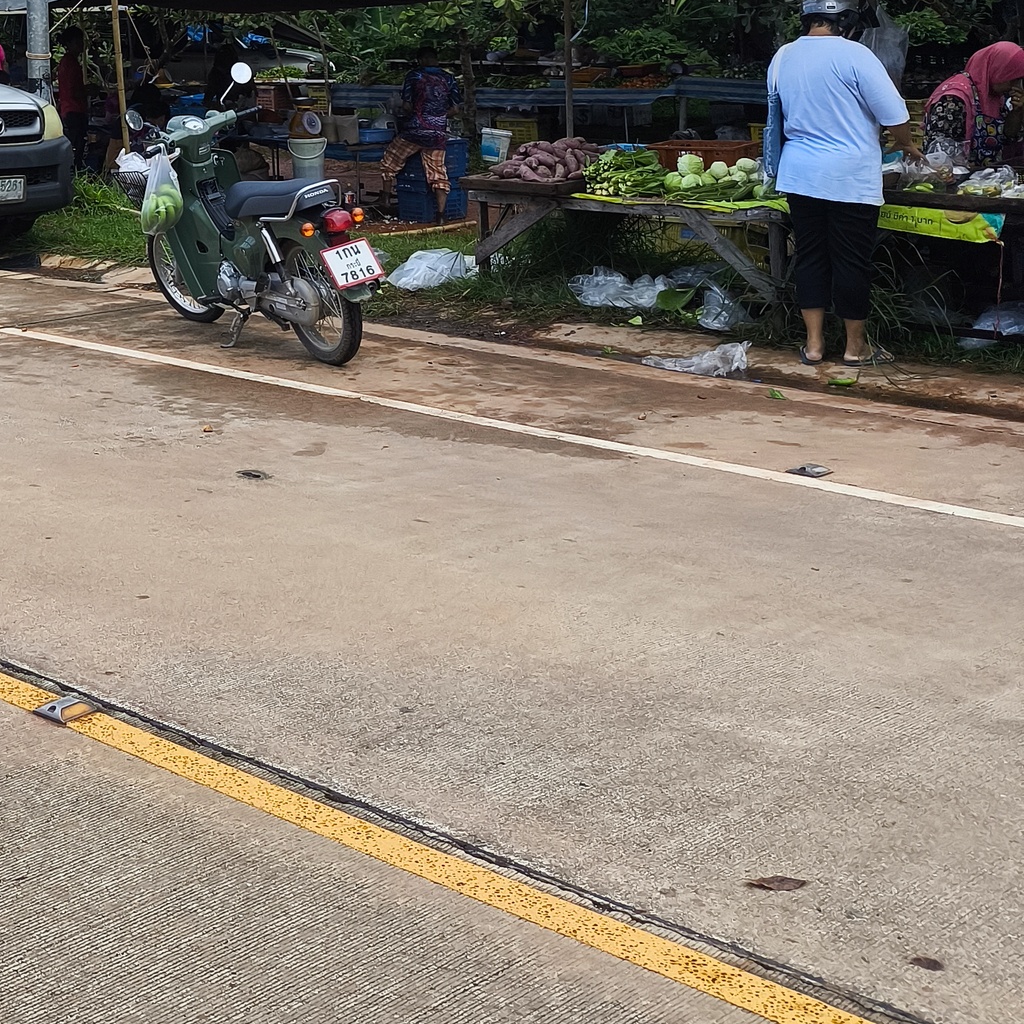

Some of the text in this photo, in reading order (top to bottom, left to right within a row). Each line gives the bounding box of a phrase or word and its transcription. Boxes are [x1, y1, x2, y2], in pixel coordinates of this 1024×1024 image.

[304, 188, 328, 198] HONDA
[335, 244, 361, 260] 1กน
[341, 265, 375, 283] 7816
